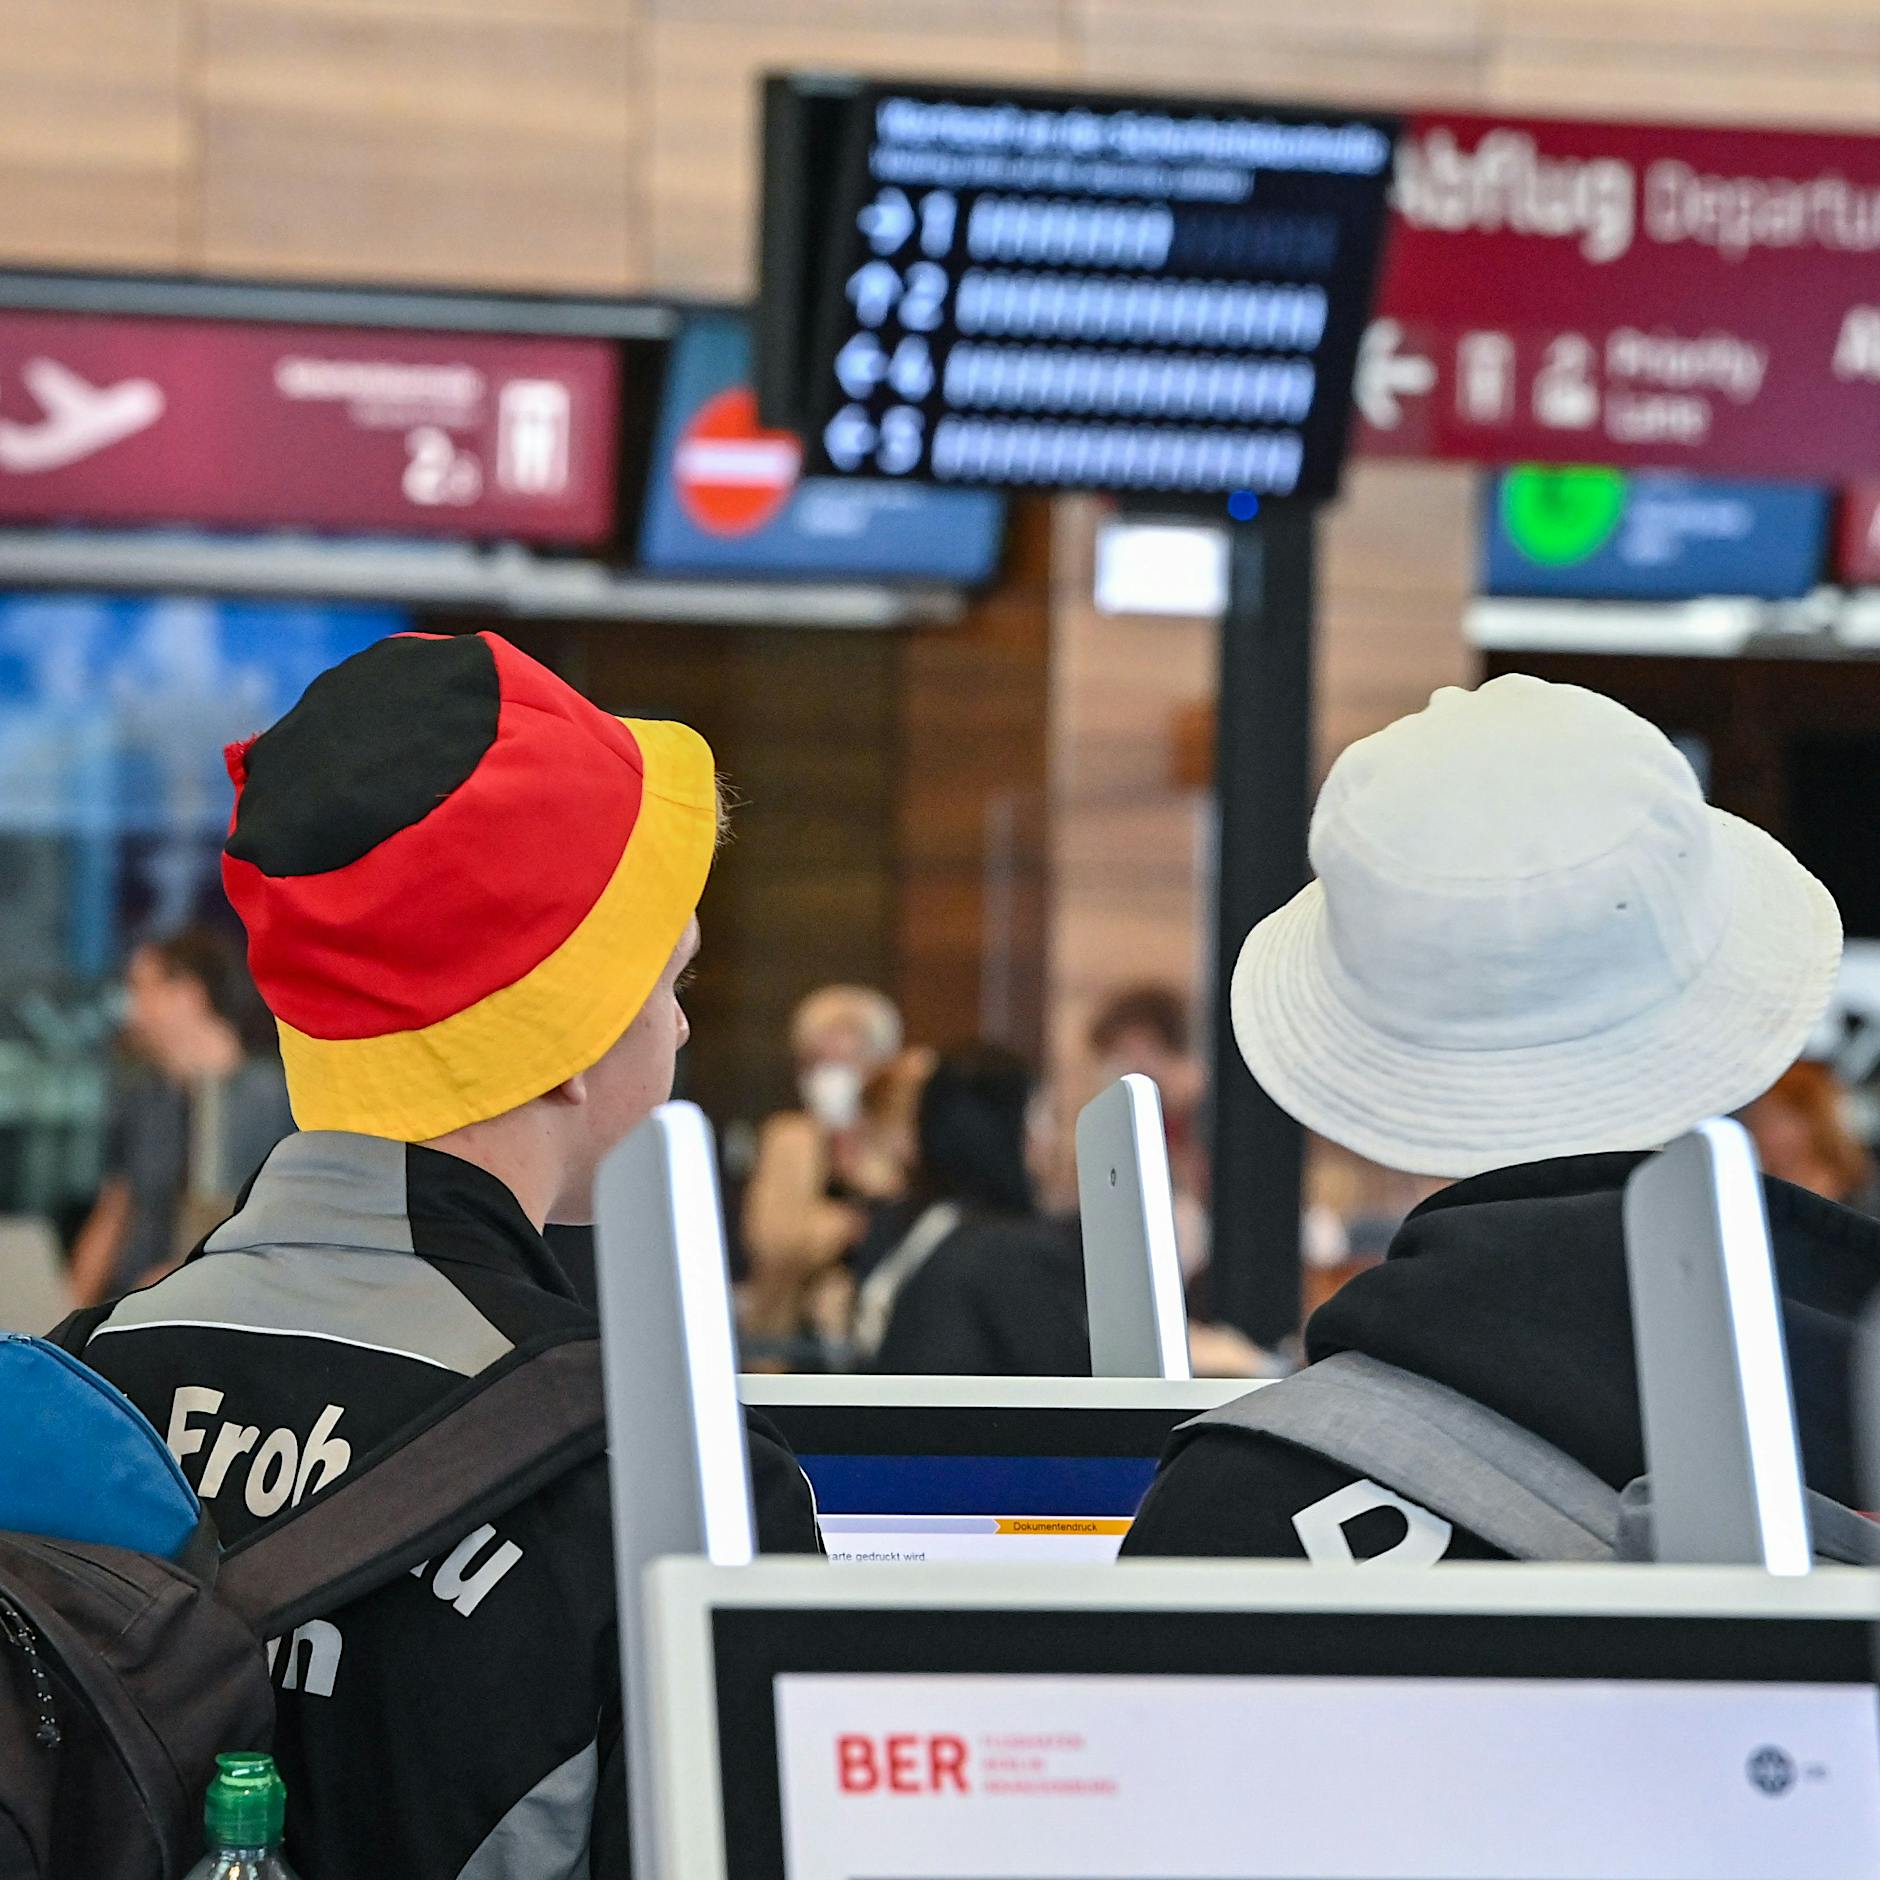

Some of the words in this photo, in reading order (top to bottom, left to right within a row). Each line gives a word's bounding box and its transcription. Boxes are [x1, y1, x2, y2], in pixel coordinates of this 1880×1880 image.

[919, 189, 957, 259] 1
[897, 260, 949, 331] 2
[855, 1552, 900, 1563] gedruckt
[903, 1552, 926, 1561] wird
[1013, 1521, 1097, 1532] Dokumentendruck
[836, 1732, 971, 1796] BER
